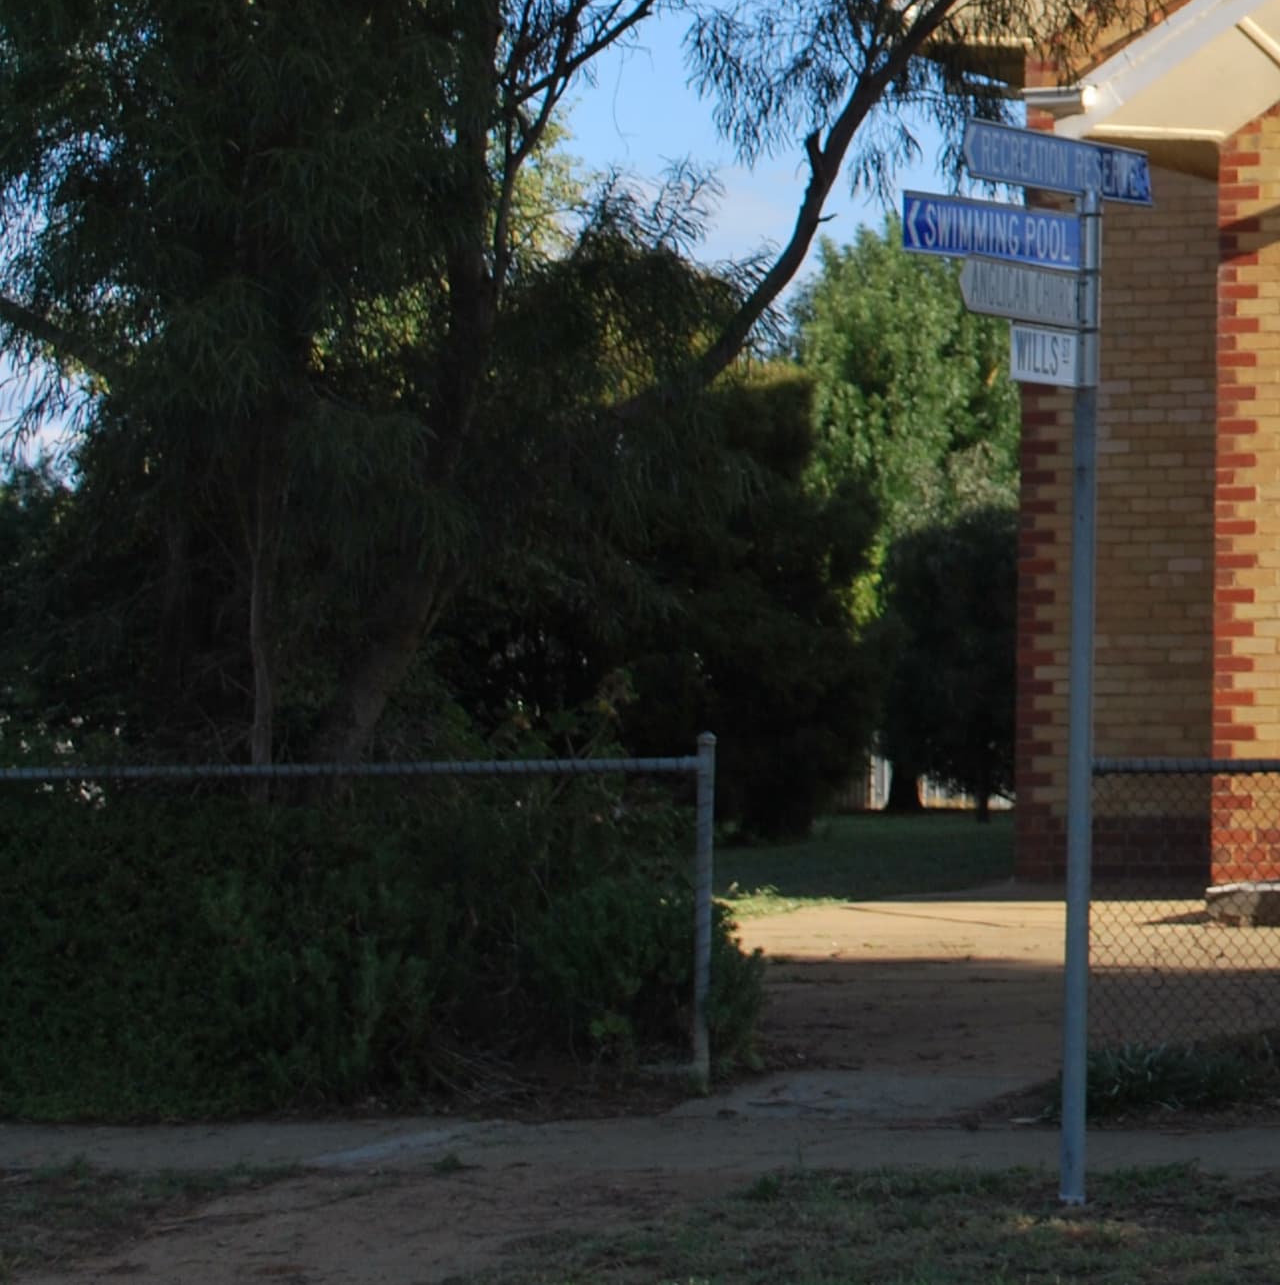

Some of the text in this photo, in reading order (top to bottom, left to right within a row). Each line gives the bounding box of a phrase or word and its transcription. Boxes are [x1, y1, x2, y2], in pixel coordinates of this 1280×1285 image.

[981, 130, 1069, 184] RECREATION
[924, 203, 1071, 262] SWIMMING POOL
[1014, 329, 1060, 378] WILLS
